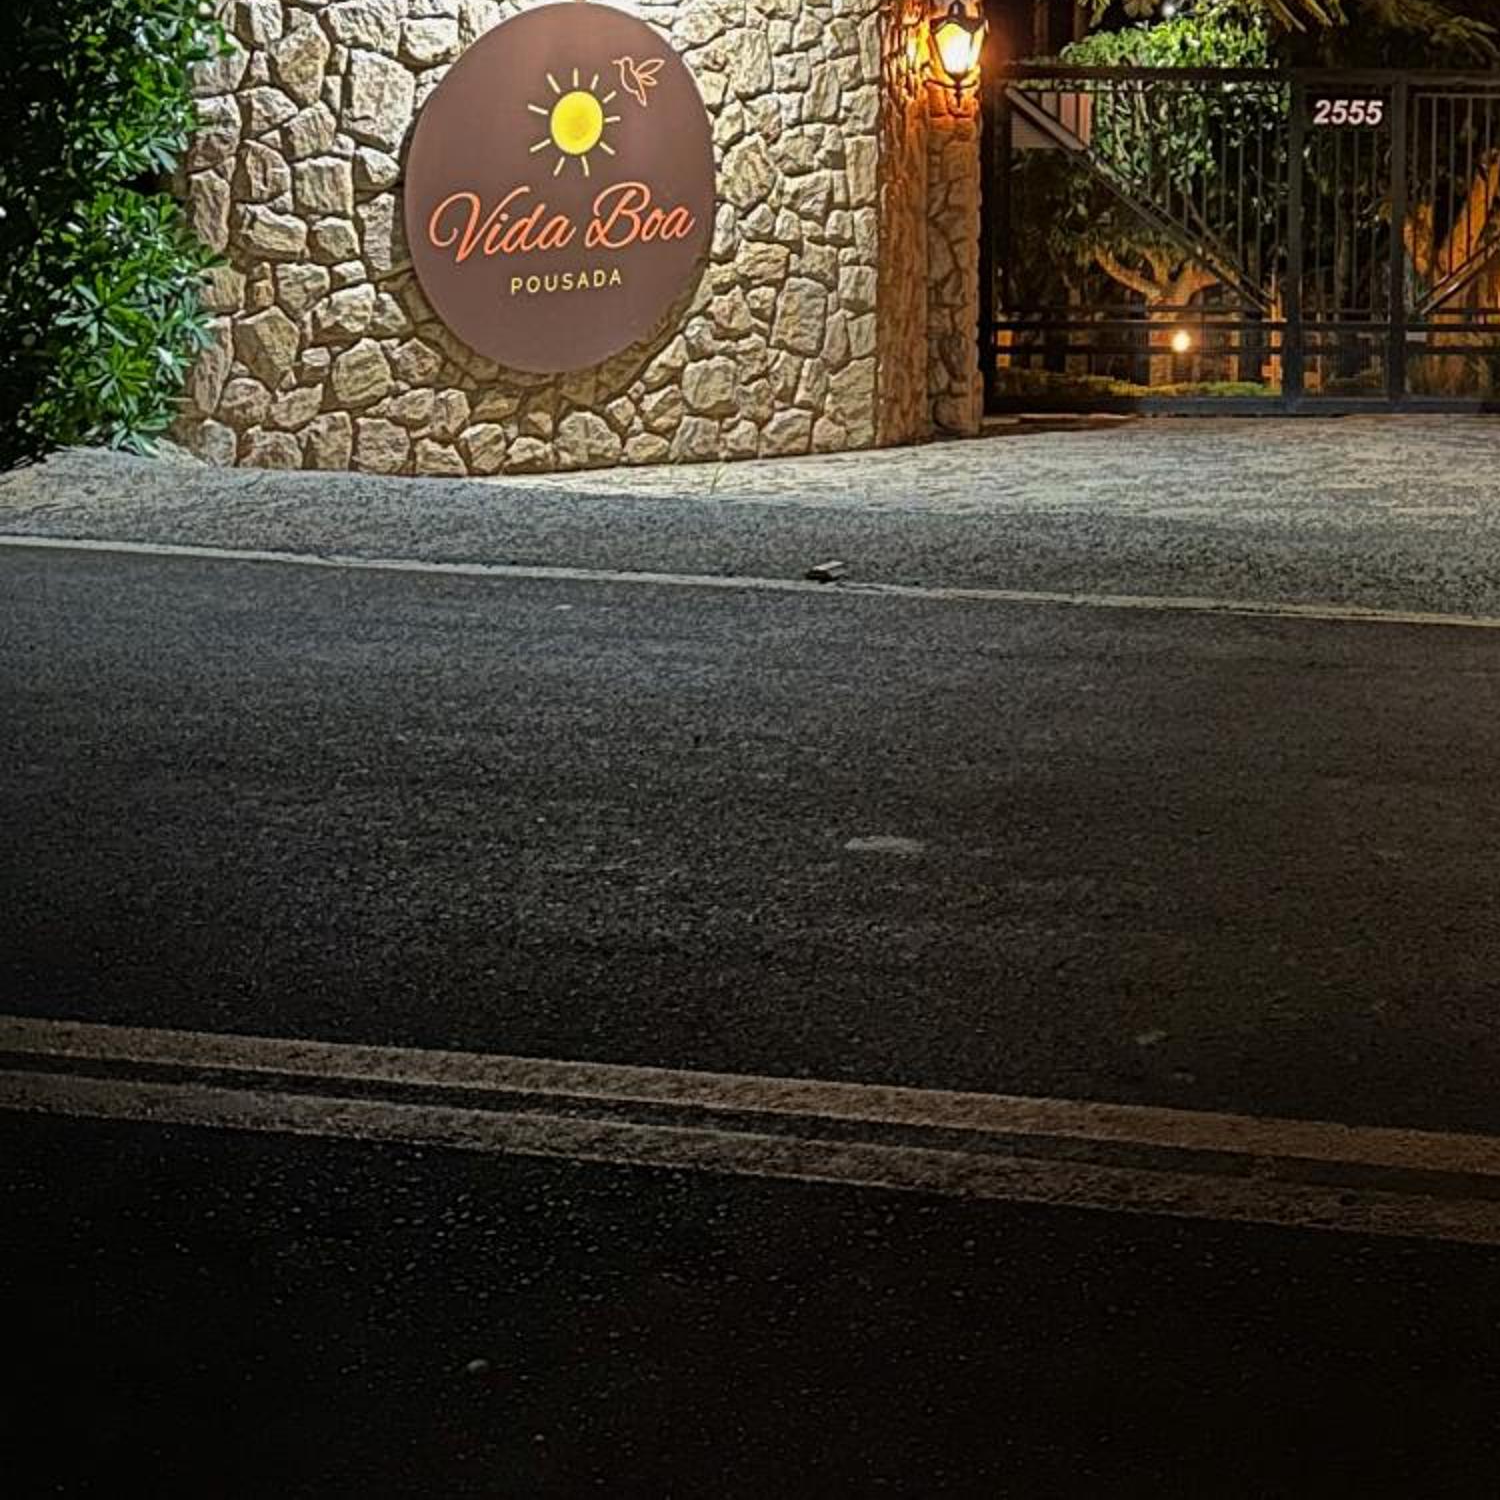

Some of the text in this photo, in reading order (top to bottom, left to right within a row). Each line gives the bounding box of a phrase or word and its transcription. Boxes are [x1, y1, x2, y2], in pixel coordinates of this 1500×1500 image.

[1313, 99, 1383, 125] 2555
[428, 182, 696, 262] Vida Boa
[510, 269, 623, 295] POUSADA
